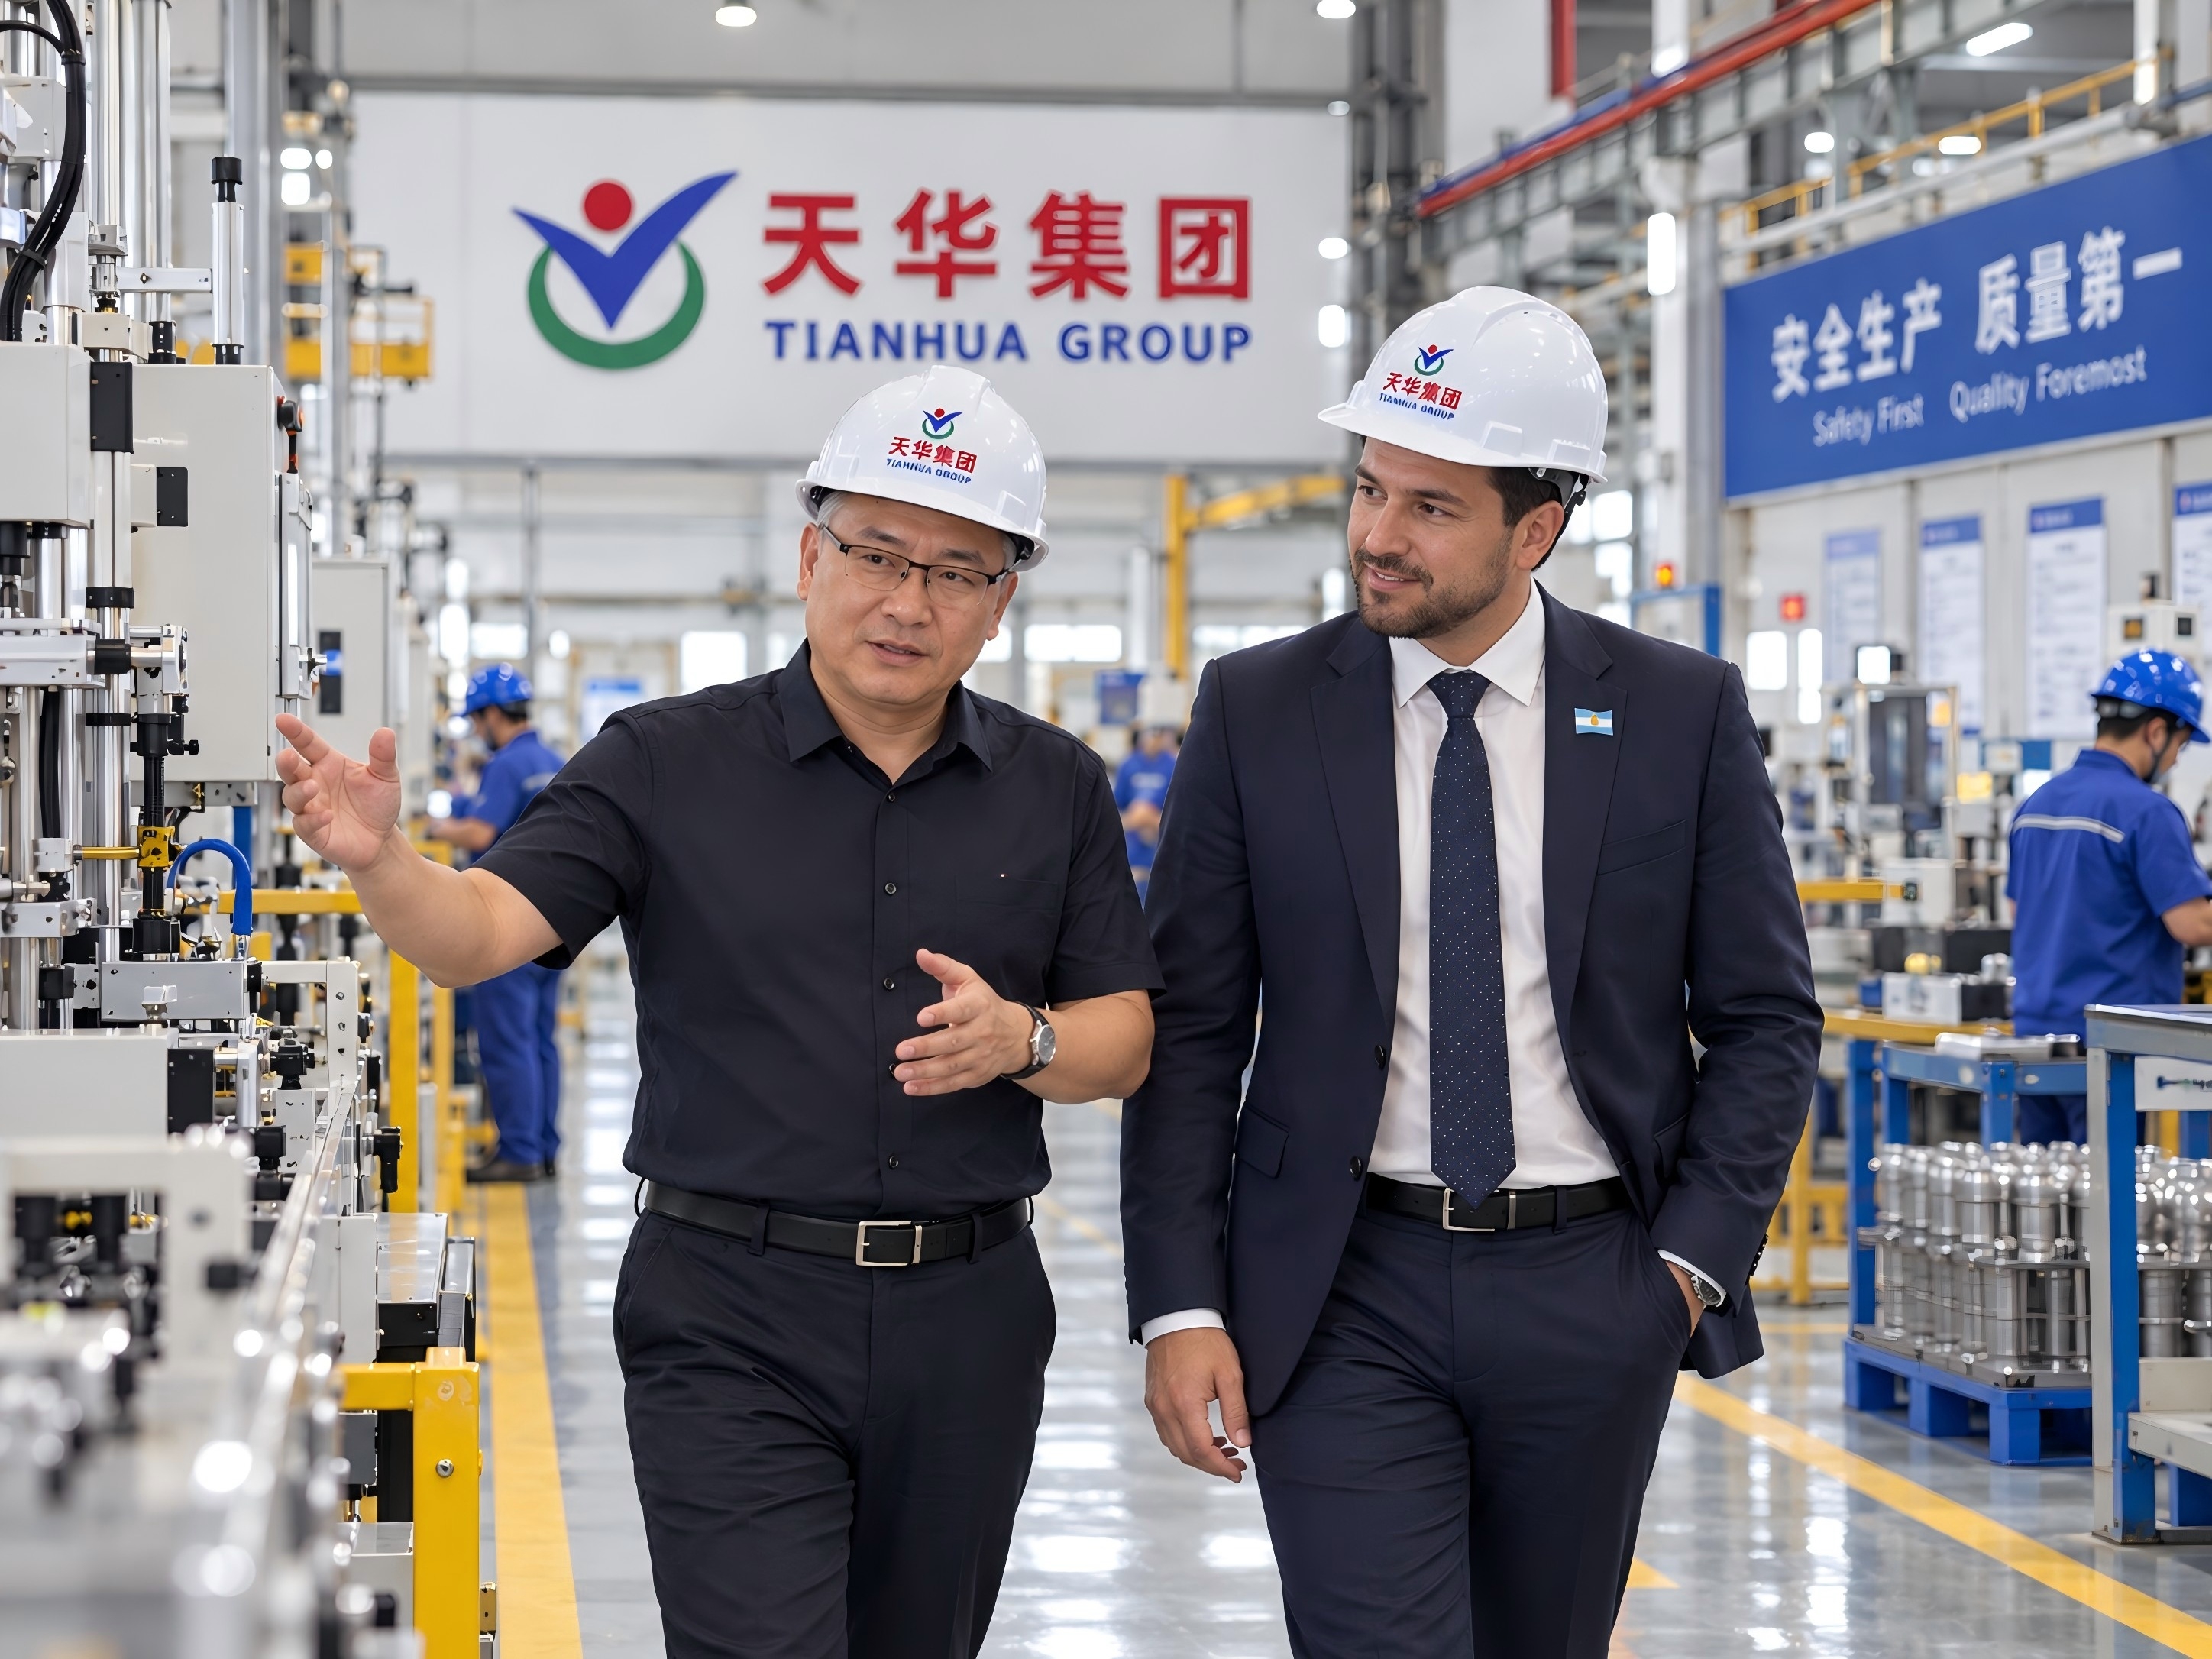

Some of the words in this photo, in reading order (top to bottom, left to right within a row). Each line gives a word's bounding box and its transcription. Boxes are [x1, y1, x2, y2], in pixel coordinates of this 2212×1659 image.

[764, 189, 1250, 299] 天华集团
[1771, 276, 1942, 403] 安全生产
[1974, 225, 2184, 355] 质量第一
[765, 321, 1029, 361] TIANHUA
[1060, 323, 1251, 363] GROUP
[1949, 371, 2030, 423] Quality
[888, 436, 978, 474] 天华集团
